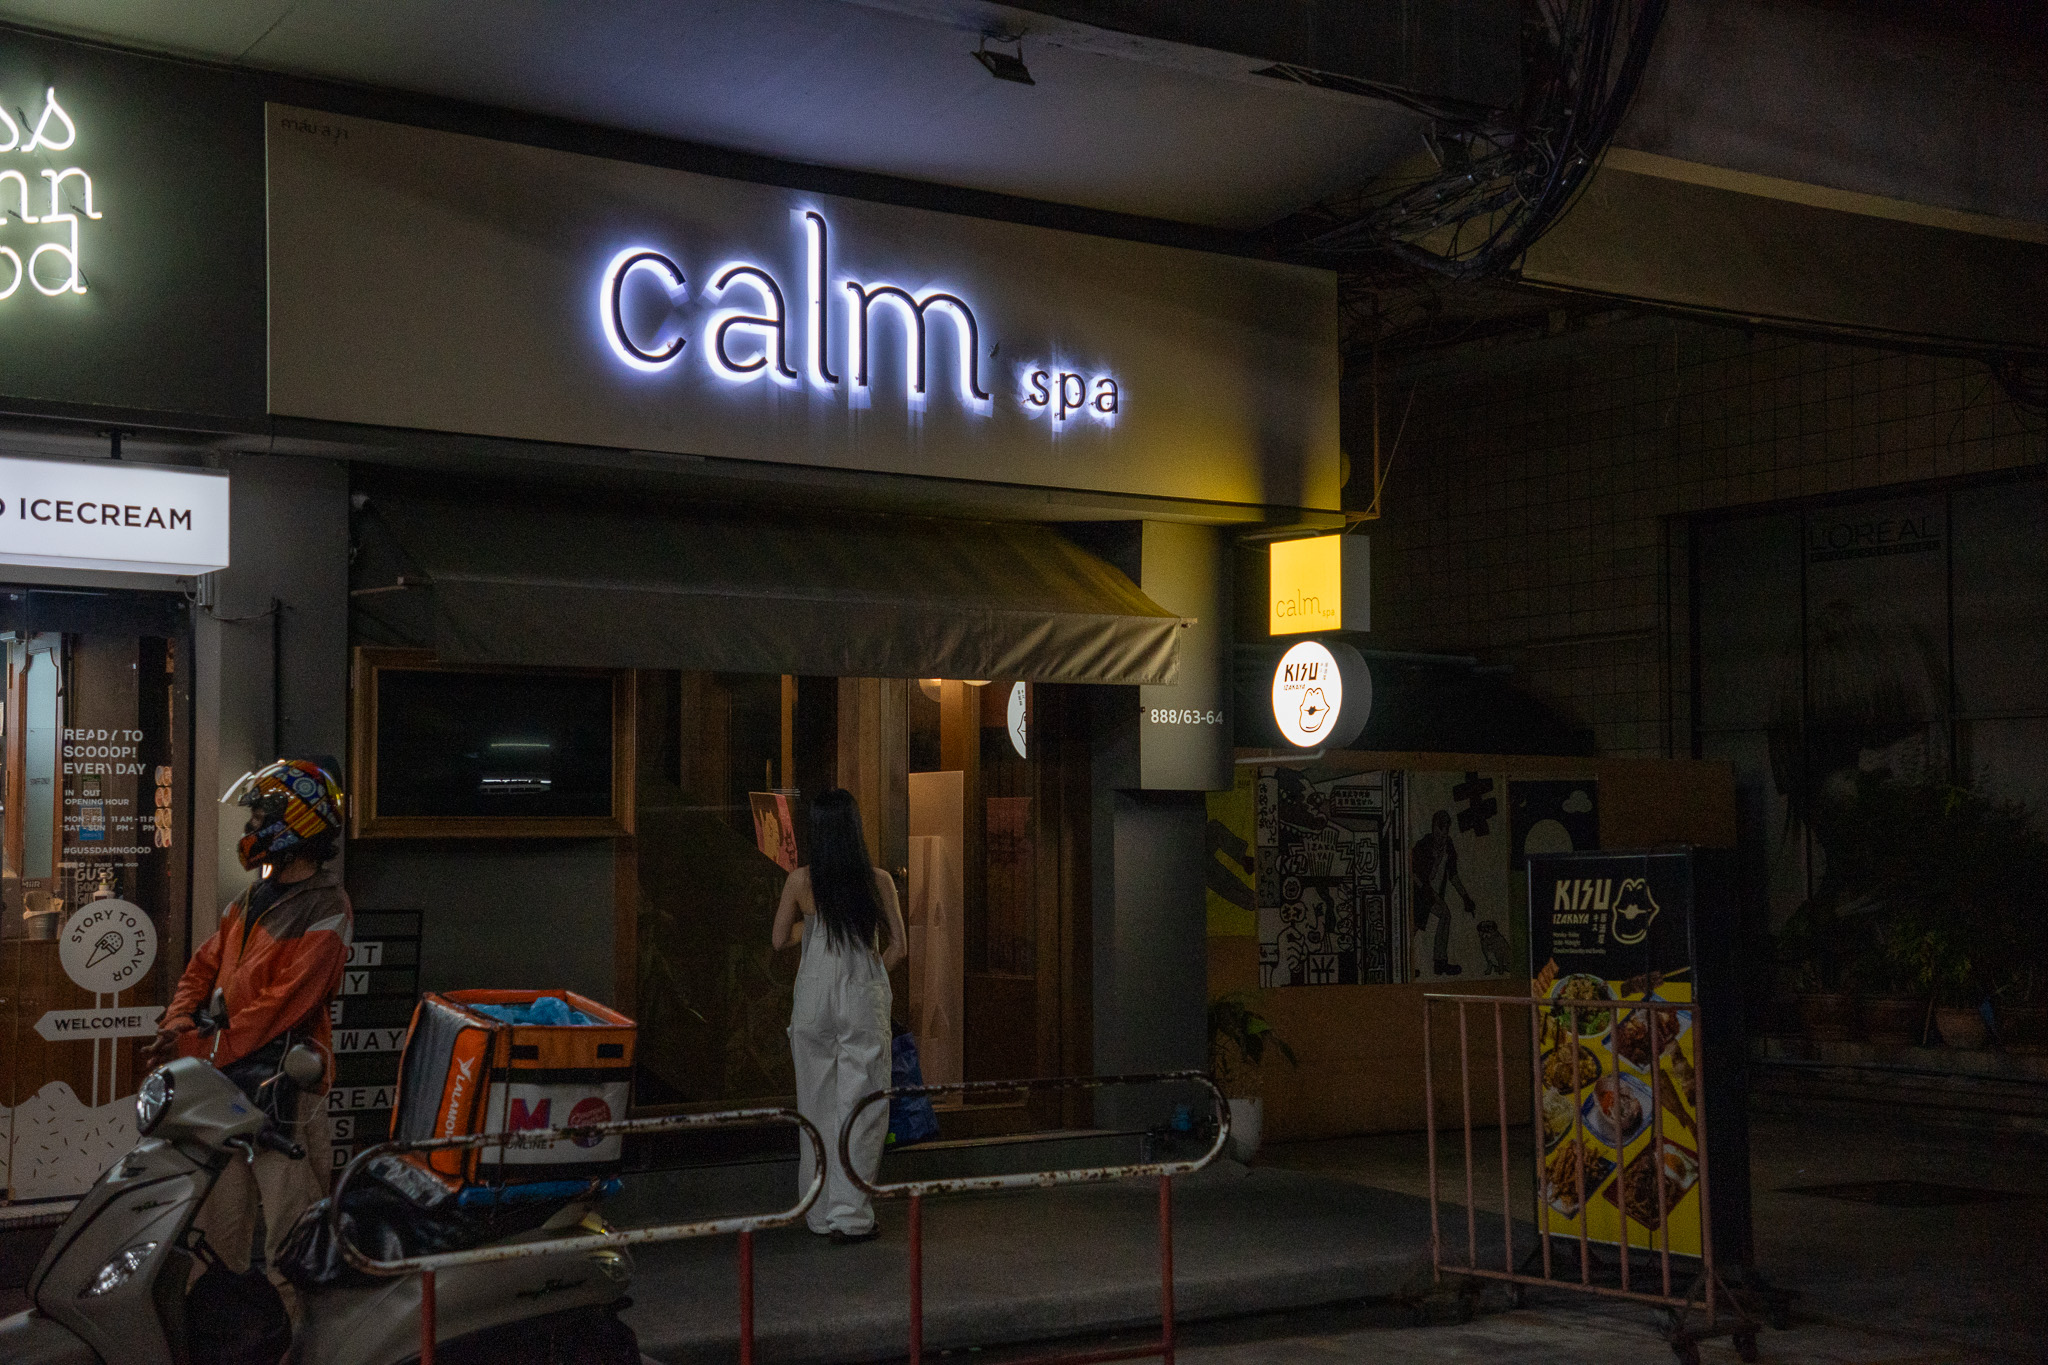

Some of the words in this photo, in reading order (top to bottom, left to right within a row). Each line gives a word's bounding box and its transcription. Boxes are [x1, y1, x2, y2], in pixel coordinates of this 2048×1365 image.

[611, 211, 990, 401] calm
[1029, 370, 1119, 421] spa
[20, 497, 192, 531] ICECREAM
[1276, 588, 1321, 618] calm
[1322, 609, 1335, 618] spa
[1284, 662, 1319, 683] KISU
[1150, 708, 1224, 725] 888/63-64
[122, 730, 144, 742] TO
[63, 745, 137, 758] SCOOOP!
[64, 789, 75, 797] IN
[82, 789, 101, 797] OUT
[64, 798, 104, 806] OPENING
[64, 815, 85, 823] MON
[64, 824, 81, 832] SAT
[88, 824, 106, 832] SUN
[116, 824, 129, 832] PM
[63, 846, 152, 855] #GUSSDAMNGOOD
[1553, 878, 1612, 911] KISU
[72, 910, 114, 943] STORY
[118, 912, 136, 928] TO
[1552, 913, 1590, 925] IZAKAYA
[113, 930, 145, 981] FLAVOR
[54, 1016, 142, 1032] WELCOME!
[443, 1074, 467, 1138] LALAMO
